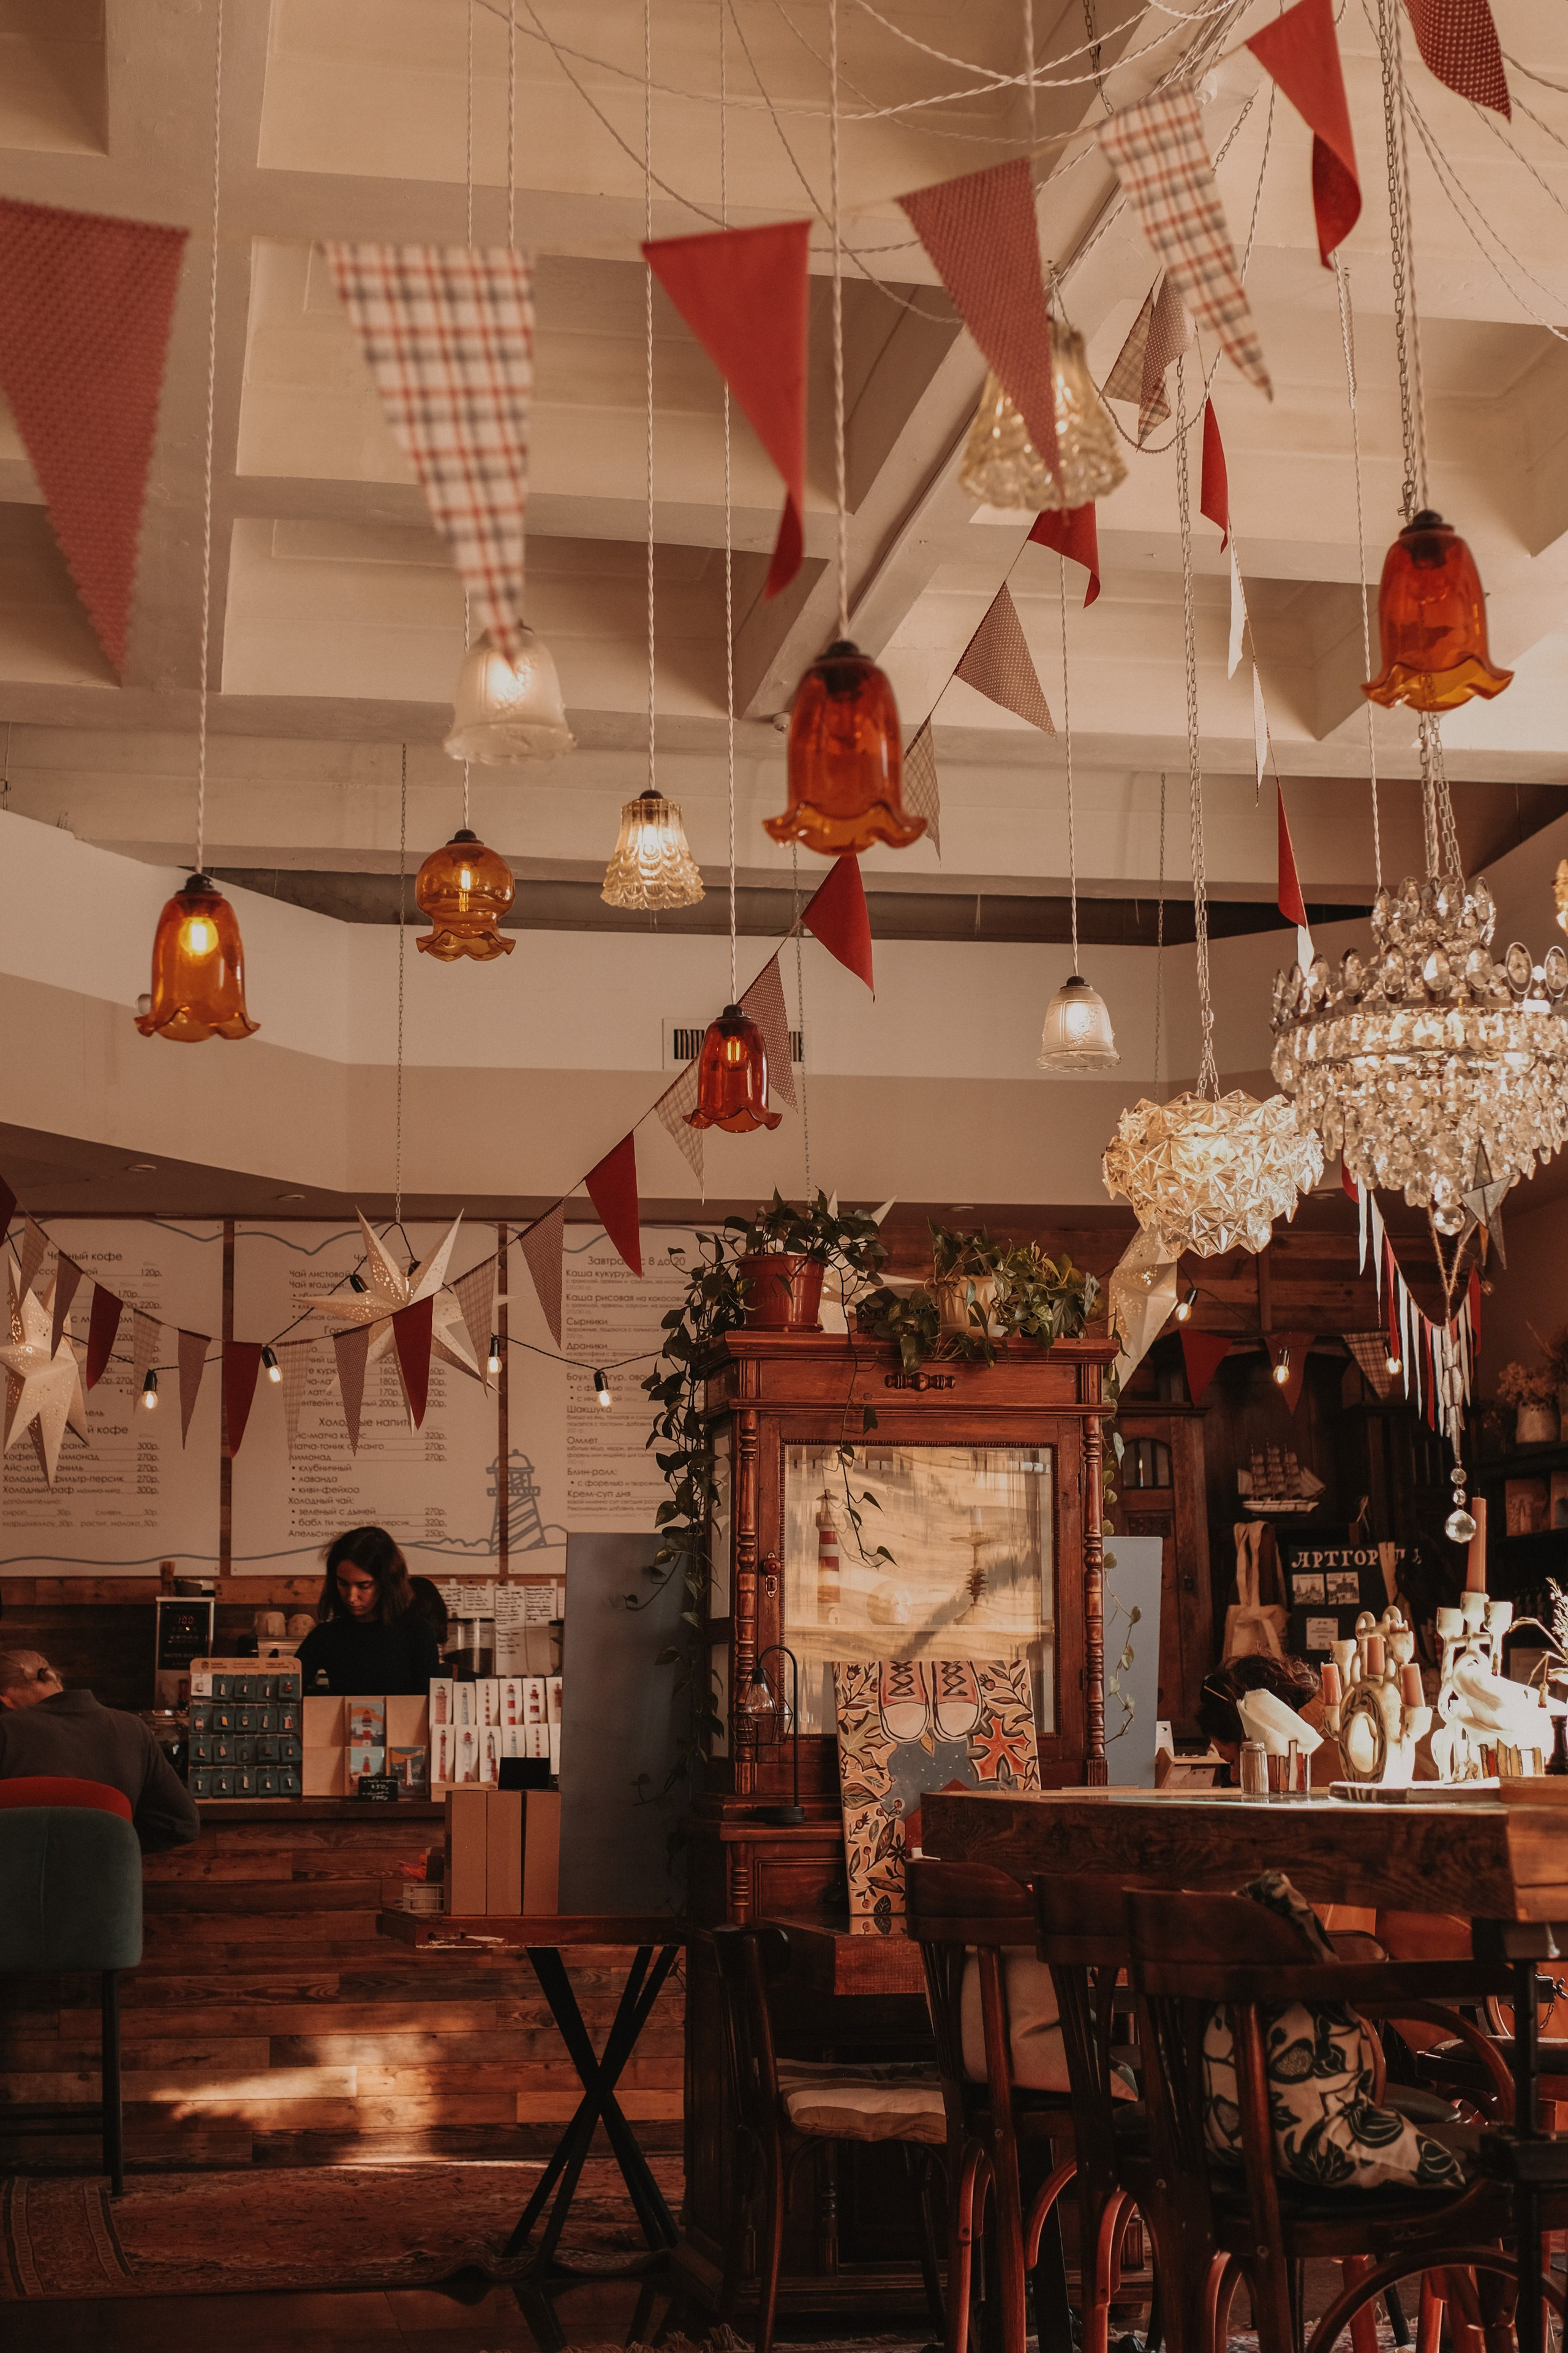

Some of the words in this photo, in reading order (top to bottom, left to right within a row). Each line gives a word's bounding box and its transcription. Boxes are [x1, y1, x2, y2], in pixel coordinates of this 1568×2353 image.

[47, 1251, 88, 1261] Ченый
[91, 1252, 123, 1262] кофе
[588, 1256, 624, 1266] Завтра
[648, 1256, 655, 1266] 8
[674, 1256, 685, 1266] 20
[595, 1294, 634, 1304] рисовая
[140, 1301, 162, 1310] 220р.
[566, 1317, 608, 1326] Сырники
[566, 1342, 608, 1351] Драники
[567, 1373, 591, 1382] Боул:
[567, 1405, 612, 1414] Шакшука
[318, 1418, 372, 1427] Холоые
[97, 1426, 129, 1435] кофе
[567, 1436, 598, 1445] Омлет
[298, 1465, 352, 1473] клубничный
[567, 1468, 618, 1476] Блин-ролл:
[137, 1475, 160, 1484] 270р.
[51, 1486, 74, 1495] раф
[567, 1490, 614, 1499] Крем-суп
